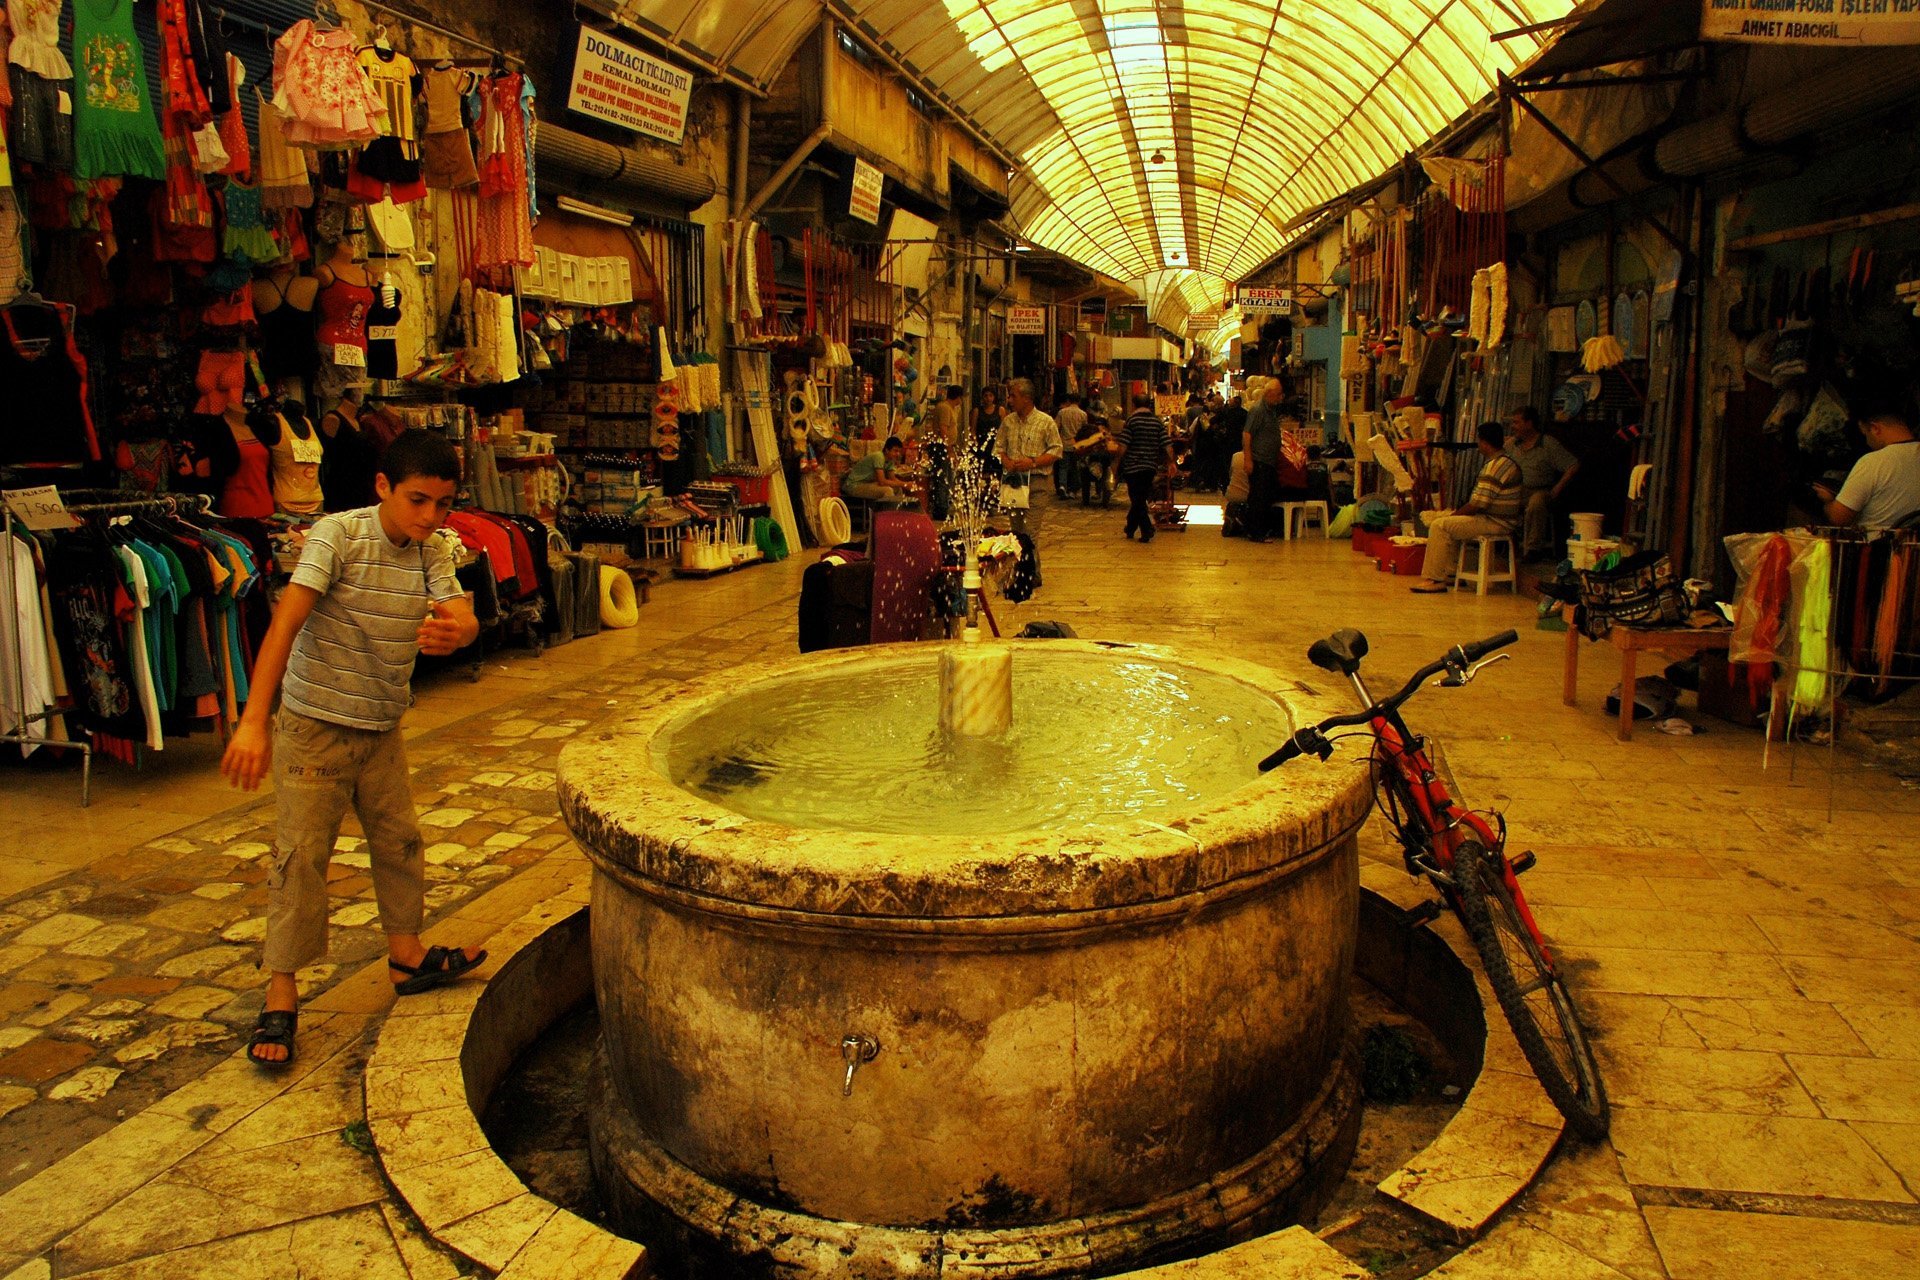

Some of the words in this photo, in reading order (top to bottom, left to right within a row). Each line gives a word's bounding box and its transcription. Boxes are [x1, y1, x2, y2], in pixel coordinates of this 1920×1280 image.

[1741, 20, 1783, 37] AHMET
[585, 35, 645, 74] DOLMACI
[601, 62, 633, 82] KEMAL
[635, 75, 671, 97] DOLMACI
[1249, 290, 1282, 298] EREN
